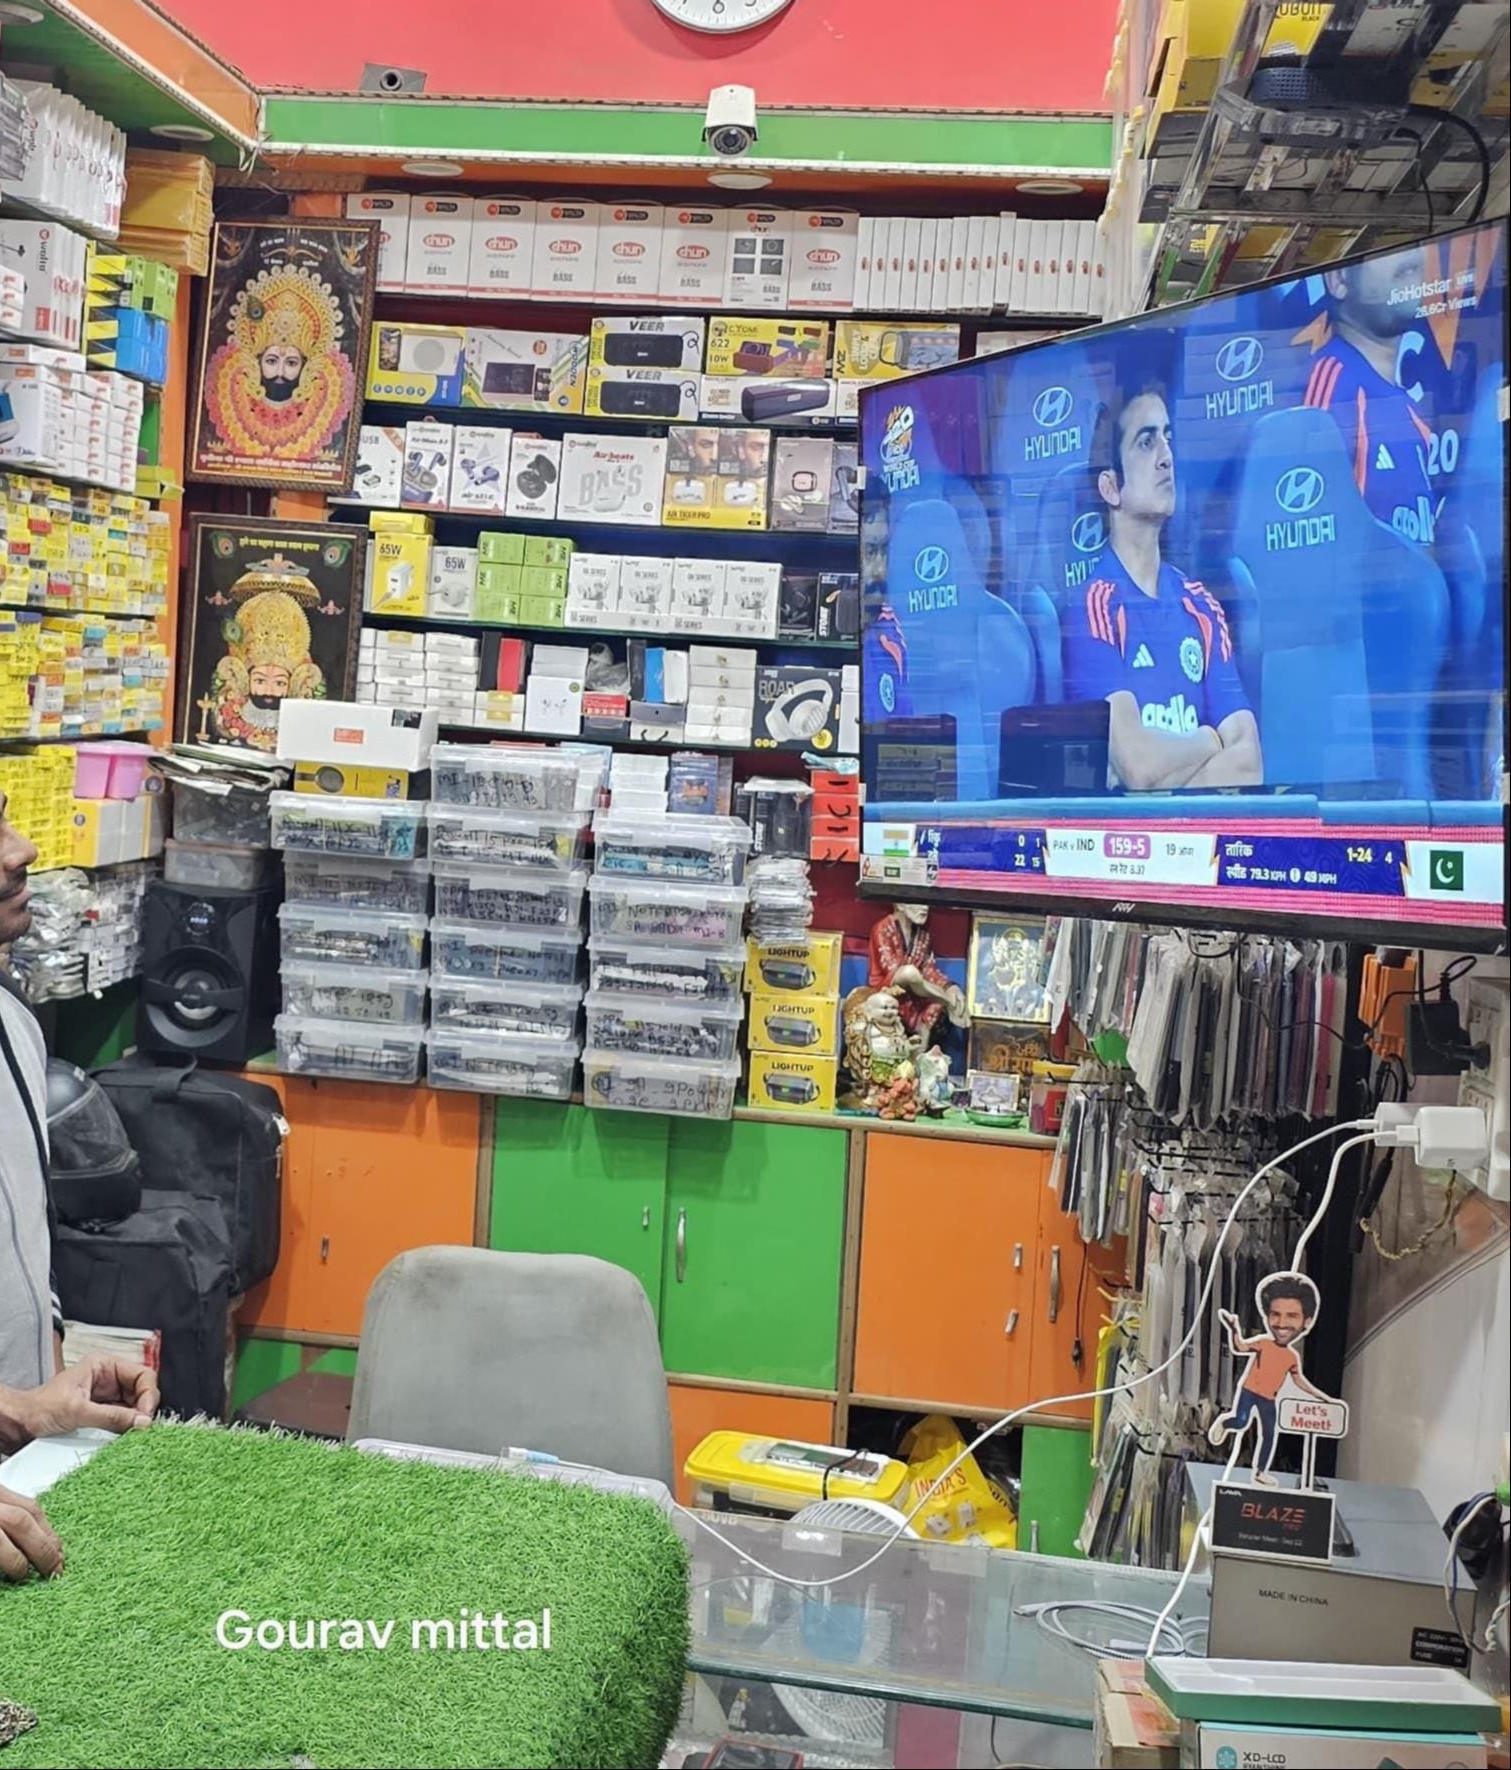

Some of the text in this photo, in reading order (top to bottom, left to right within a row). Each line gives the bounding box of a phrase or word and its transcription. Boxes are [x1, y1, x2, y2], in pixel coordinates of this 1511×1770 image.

[1386, 277, 1452, 306] JioHotstar
[629, 321, 665, 332] VEER
[710, 339, 730, 348] 622
[627, 370, 662, 380] VEER
[1205, 380, 1274, 420] HYUNDAI
[1025, 425, 1081, 461] HYUNDAI
[1265, 514, 1336, 551] HYUNDAI
[379, 543, 402, 555] 65W
[444, 557, 466, 569] 65W
[908, 584, 958, 613] HYUNDAI
[1018, 835, 1025, 846] 0
[1052, 839, 1068, 850] PAK
[1076, 838, 1095, 851] IND
[1109, 837, 1146, 856] 159-5
[1166, 843, 1176, 856] 19
[1014, 854, 1025, 867] 22
[1385, 851, 1393, 864] 4
[1304, 871, 1318, 883] 49
[768, 947, 810, 958] LIGHTUP
[772, 1004, 815, 1015] LIGHTUP
[770, 1061, 814, 1073] LIGHTUP
[1295, 1402, 1328, 1418] Let's
[1290, 1415, 1332, 1432] Meet!
[1240, 1502, 1306, 1524] BLAZE
[1258, 1589, 1329, 1607] MADE IN CHINA
[1242, 1751, 1287, 1764] XD-LCD
